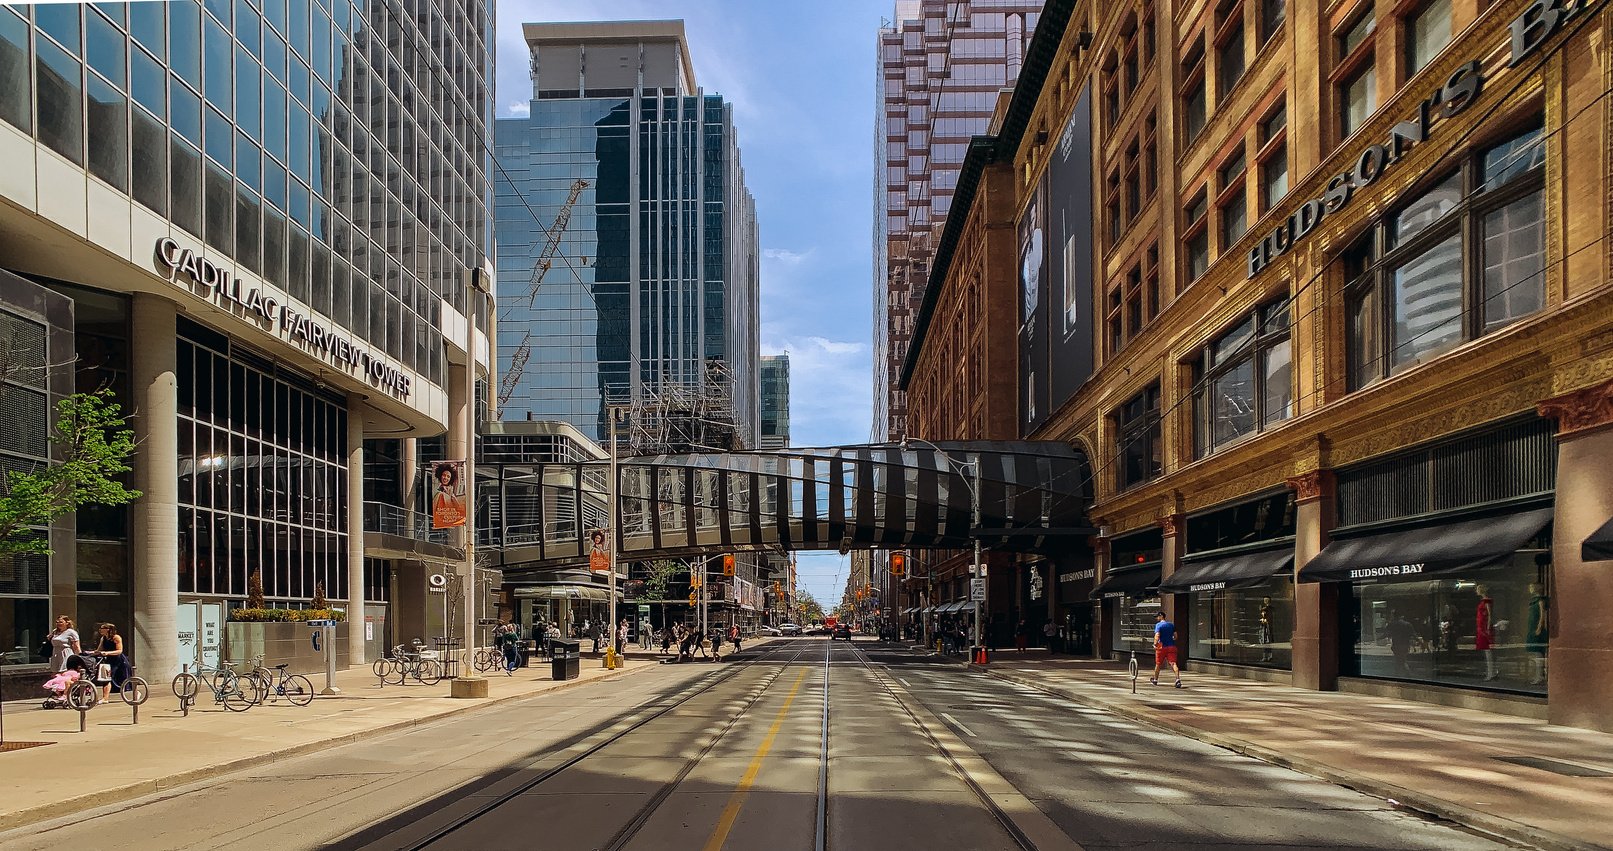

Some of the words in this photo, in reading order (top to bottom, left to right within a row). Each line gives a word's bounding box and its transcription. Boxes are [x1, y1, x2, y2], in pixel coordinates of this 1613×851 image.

[1247, 60, 1485, 279] HUDSON'S
[154, 236, 279, 321] CADILLAC
[280, 305, 362, 368] FAIRVIEW
[363, 352, 412, 396] TOWER
[1083, 568, 1095, 578] BAY
[1350, 566, 1400, 578] HUDSON'S
[1401, 563, 1425, 574] BAY
[1190, 583, 1214, 591] HUDSON'S
